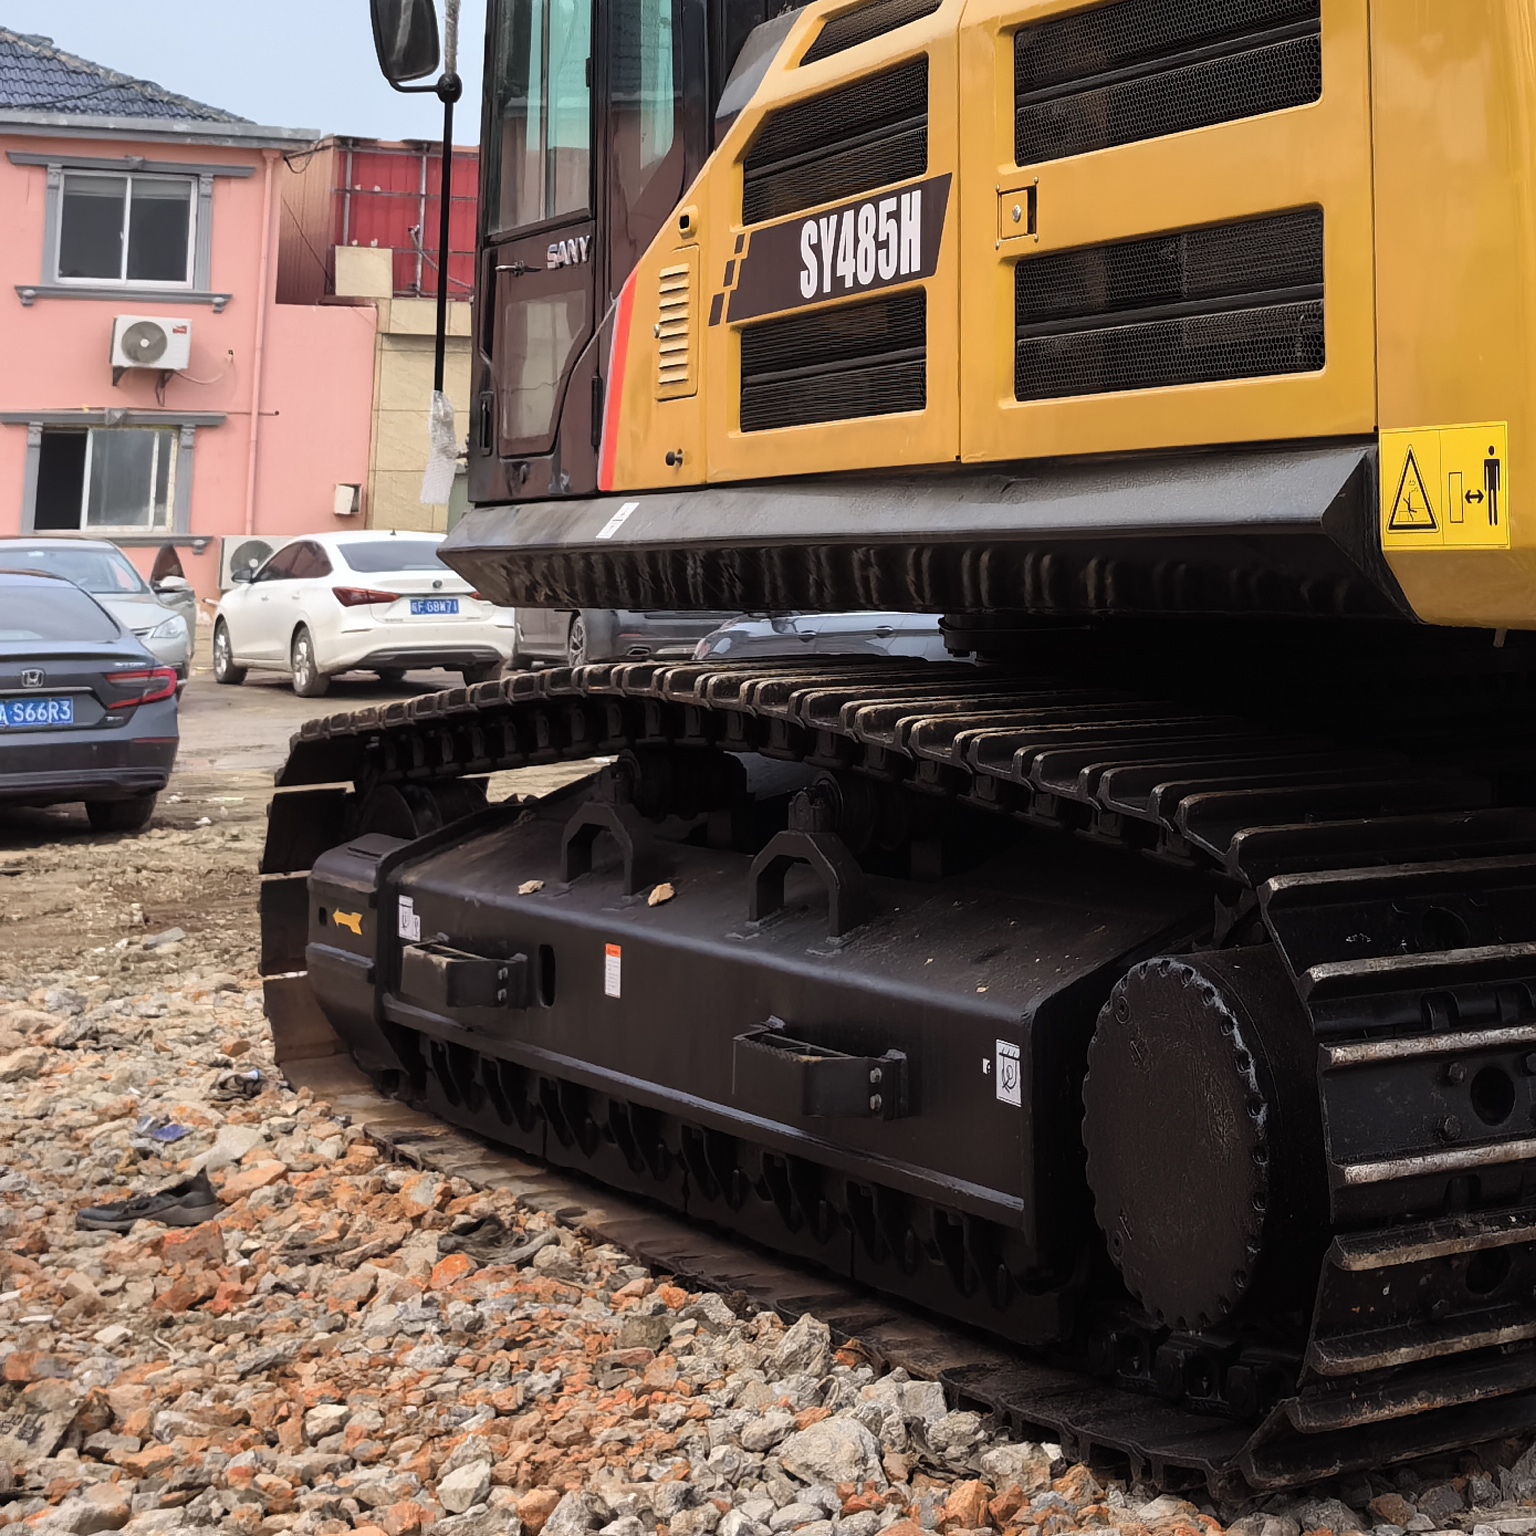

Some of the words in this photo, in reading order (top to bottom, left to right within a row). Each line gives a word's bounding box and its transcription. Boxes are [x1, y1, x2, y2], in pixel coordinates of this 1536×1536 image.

[547, 235, 591, 269] SANY
[800, 189, 922, 299] SY485H
[0, 700, 71, 725] A·S66R3
